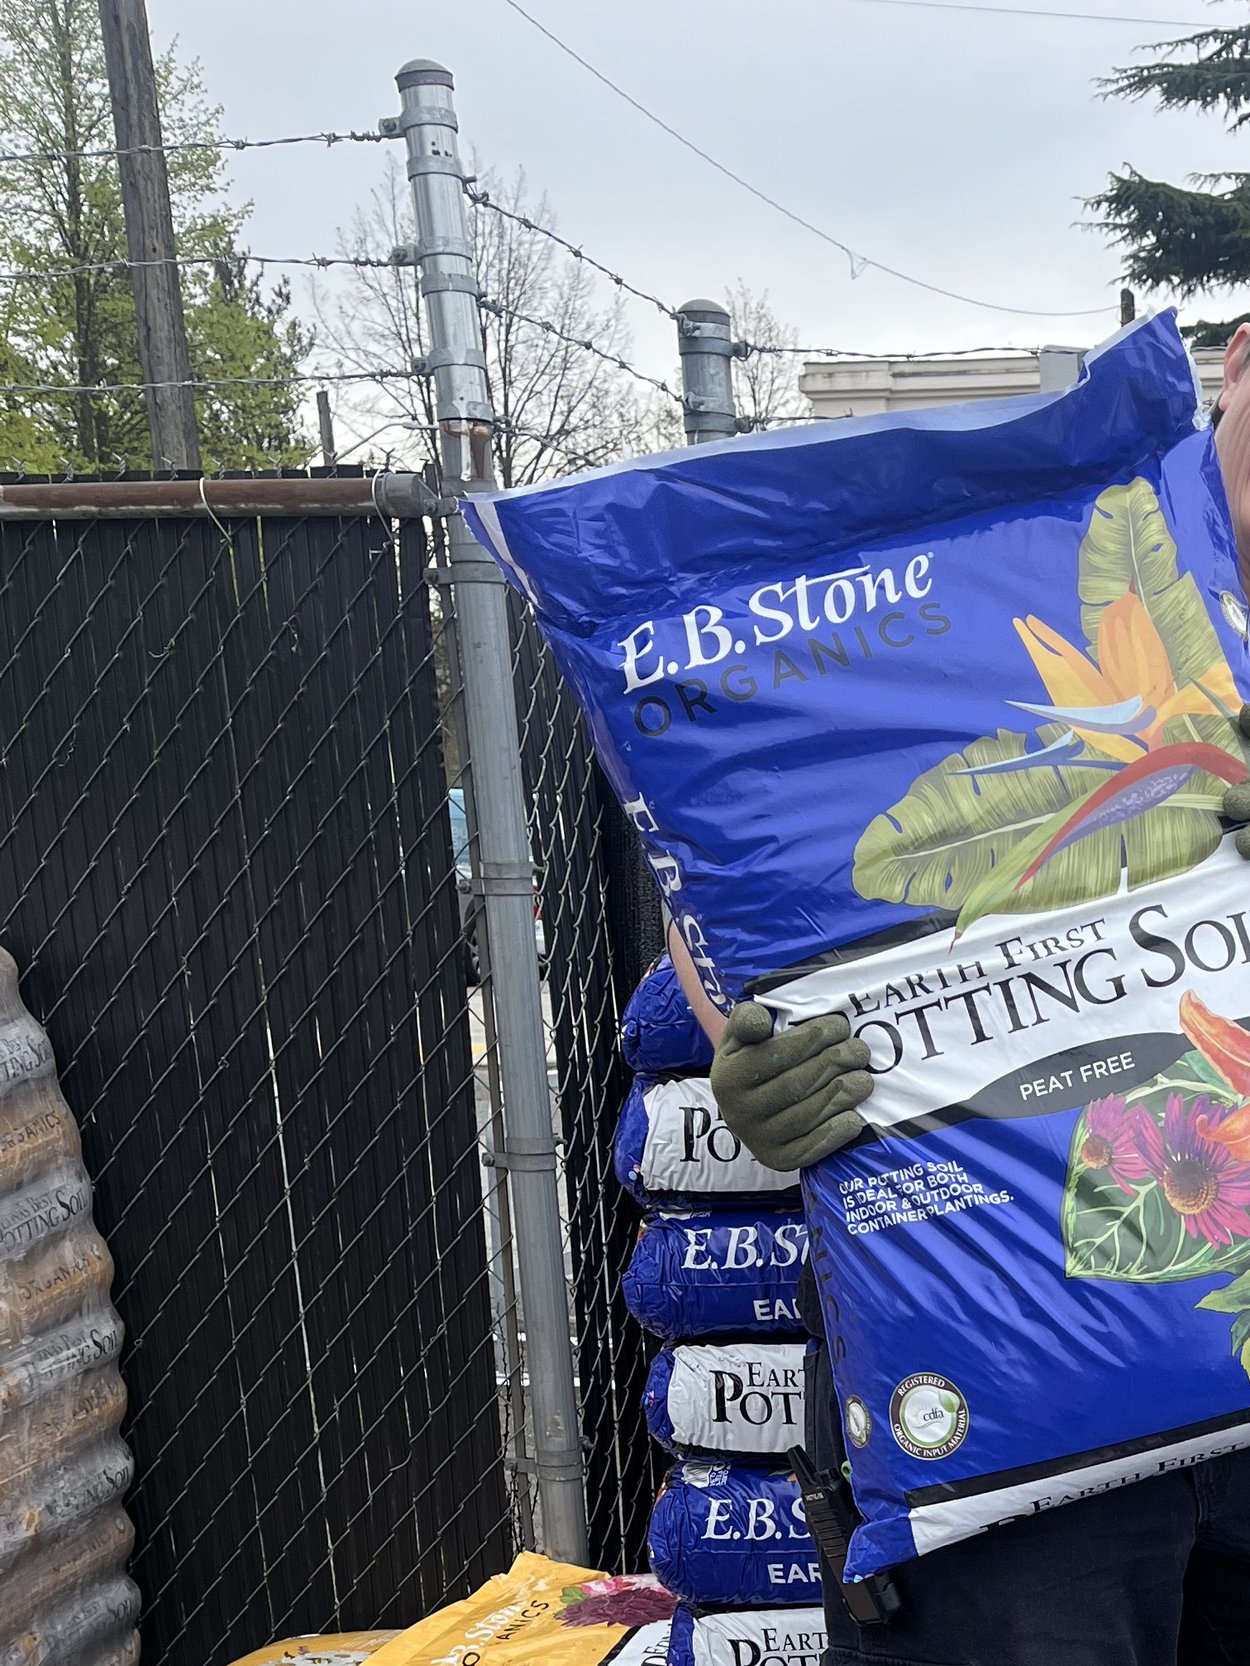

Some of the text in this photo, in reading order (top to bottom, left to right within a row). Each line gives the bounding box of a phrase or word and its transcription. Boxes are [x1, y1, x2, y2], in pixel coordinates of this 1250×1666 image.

[632, 602, 953, 737] ORGANICS
[995, 917, 1107, 969] FIRST
[1020, 1051, 1136, 1101] PEAT FREE
[927, 1160, 964, 1176] SOIL
[928, 1172, 969, 1189] BOTH
[846, 1200, 898, 1223] INDOOR
[896, 1374, 946, 1398] REGISTERED
[922, 1407, 946, 1423] cdfa
[893, 1422, 922, 1458] ORGANIC
[921, 1446, 949, 1458] INPUT
[946, 1407, 967, 1452] MATERIAL
